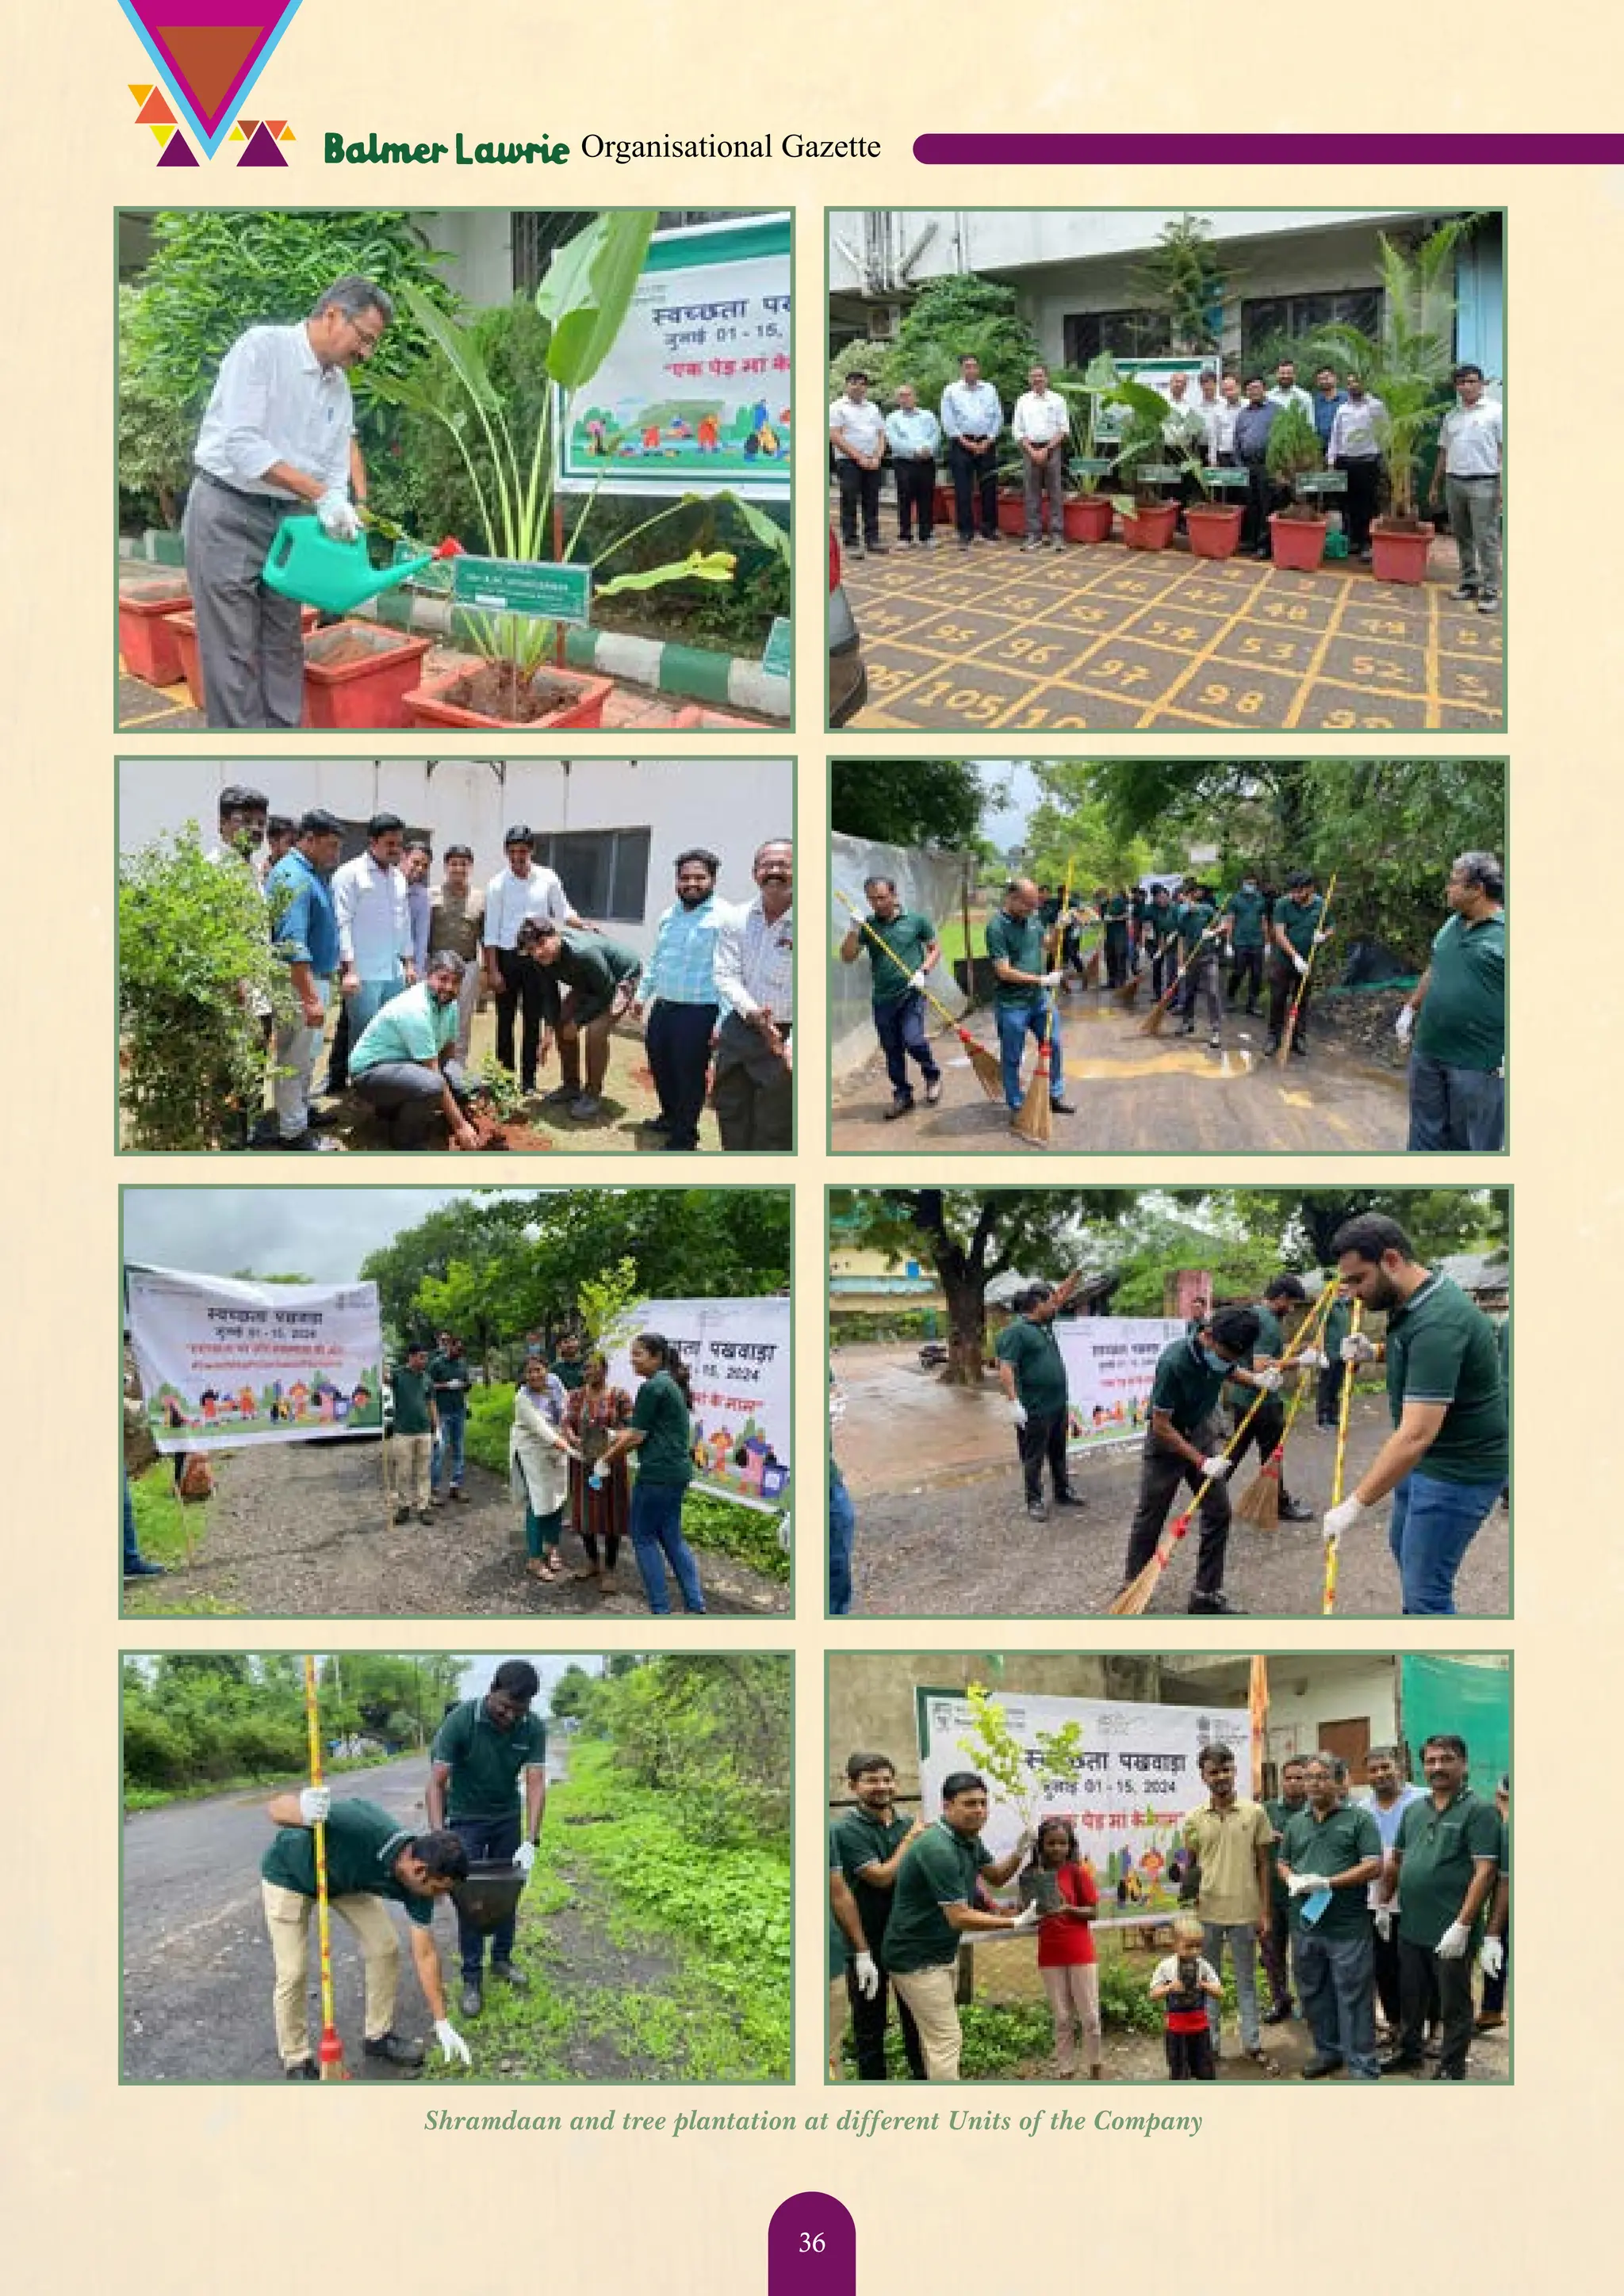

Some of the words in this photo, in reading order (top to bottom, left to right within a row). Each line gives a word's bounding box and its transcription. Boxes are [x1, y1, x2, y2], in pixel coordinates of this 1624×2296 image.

[324, 132, 449, 164] Balmer
[456, 133, 570, 164] Lawrie
[582, 134, 772, 164] Organisational
[782, 134, 880, 158] Gazette
[717, 327, 737, 342] 01
[913, 682, 1005, 718] 105
[1198, 684, 1265, 713] 98
[710, 1342, 778, 1363] पखवाड़ा
[1120, 1753, 1186, 1774] पखवाड़ा
[1143, 1781, 1176, 1793] 2024
[424, 2110, 561, 2130] Shramdaan
[570, 2110, 615, 2130] and
[623, 2114, 666, 2130] tree
[672, 2110, 796, 2137] plantation
[805, 2114, 829, 2130] at
[837, 2110, 940, 2137] different
[950, 2110, 1011, 2130] Units
[1020, 2110, 1046, 2137] of
[1051, 2110, 1086, 2130] the
[1094, 2110, 1202, 2137] Company
[799, 2233, 825, 2252] 36
